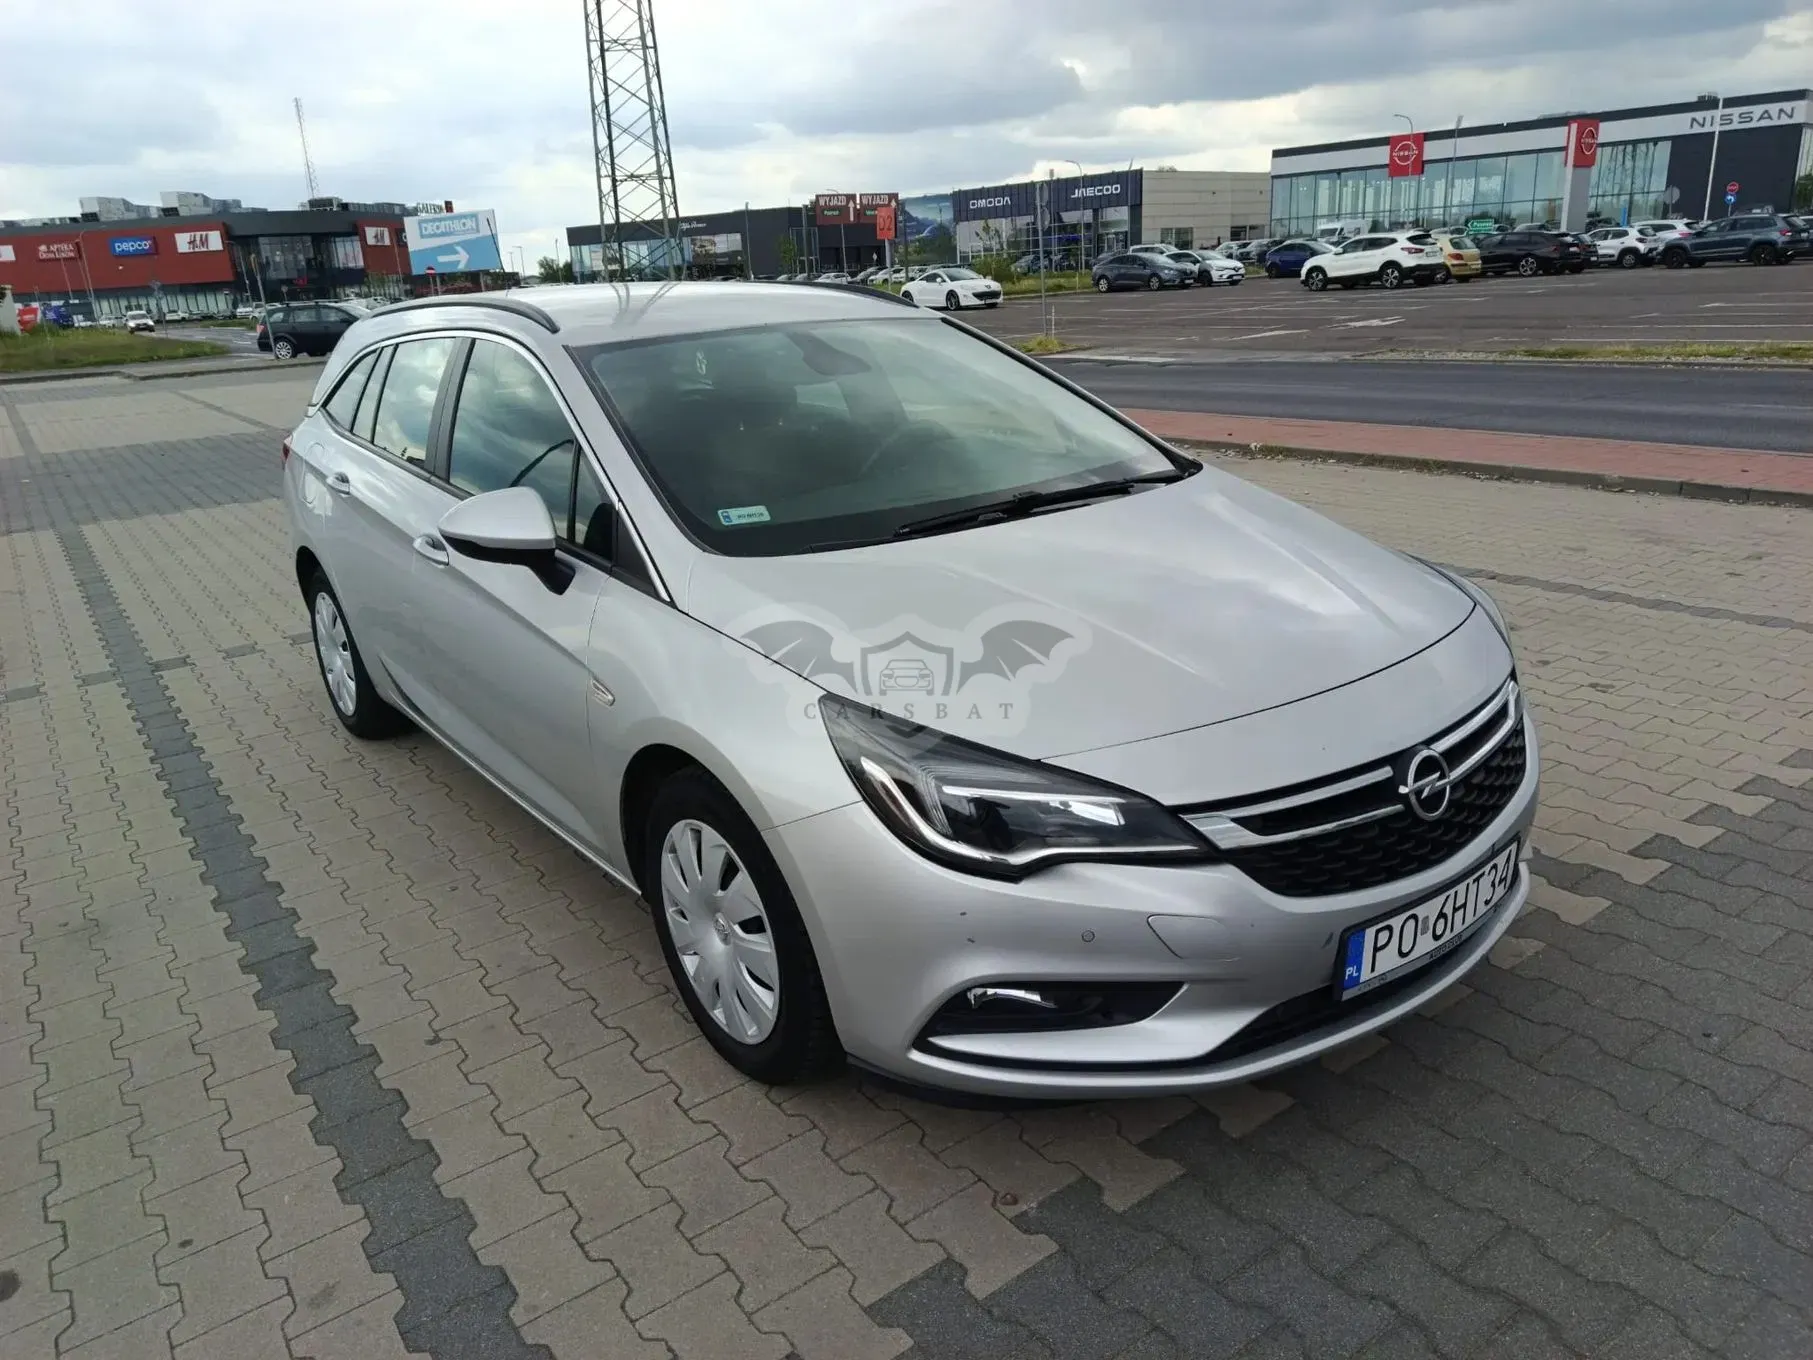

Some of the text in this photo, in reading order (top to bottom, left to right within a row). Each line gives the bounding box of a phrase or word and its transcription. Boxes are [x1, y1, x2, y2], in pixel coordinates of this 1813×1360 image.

[1689, 107, 1795, 129] NISSAN
[1071, 184, 1121, 198] JAECOO
[818, 195, 847, 206] WYJAZD
[861, 195, 889, 205] WYJAZD
[969, 197, 1011, 209] OMODA
[422, 217, 477, 235] DECATHLON
[114, 241, 149, 253] pepco
[187, 233, 209, 250] H&M
[1370, 849, 1513, 973] PO 6HT34
[1345, 965, 1359, 980] PL
